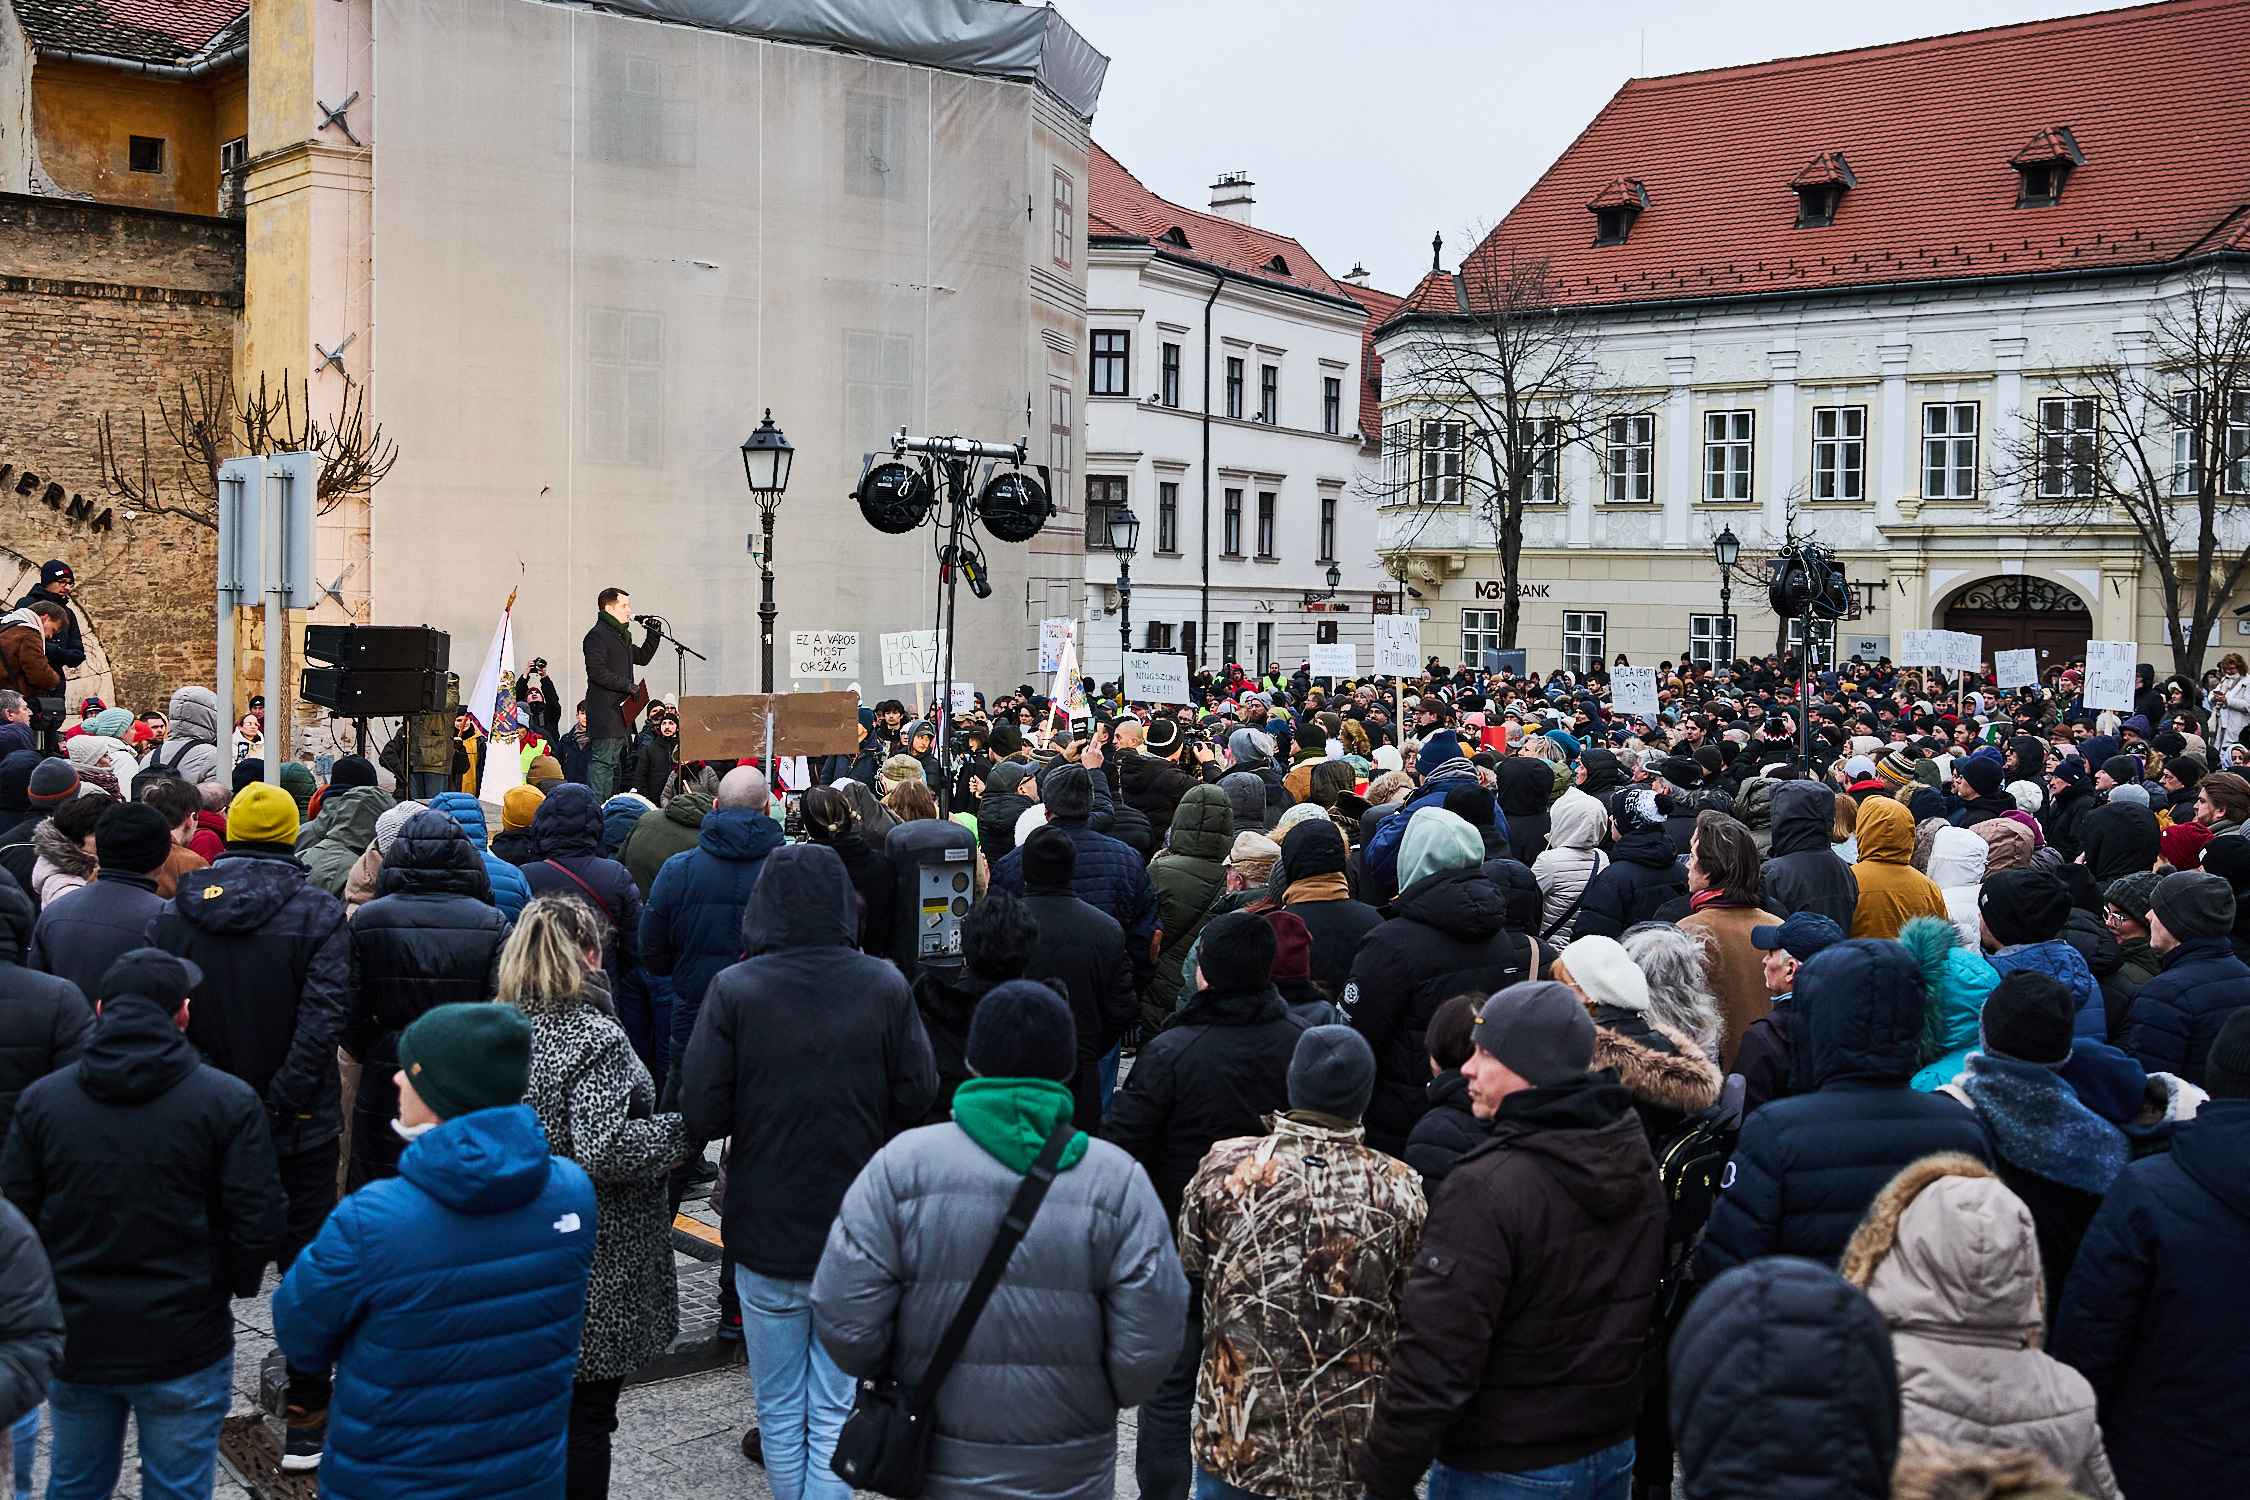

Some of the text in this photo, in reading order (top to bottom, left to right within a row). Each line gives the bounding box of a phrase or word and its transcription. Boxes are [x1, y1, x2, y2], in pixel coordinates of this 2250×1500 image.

[796, 633, 856, 646] EZ A VÁROS
[886, 635, 921, 651] HOL
[813, 646, 846, 657] MOST
[801, 660, 847, 673] ORSZÁG
[1131, 660, 1150, 669] NEM
